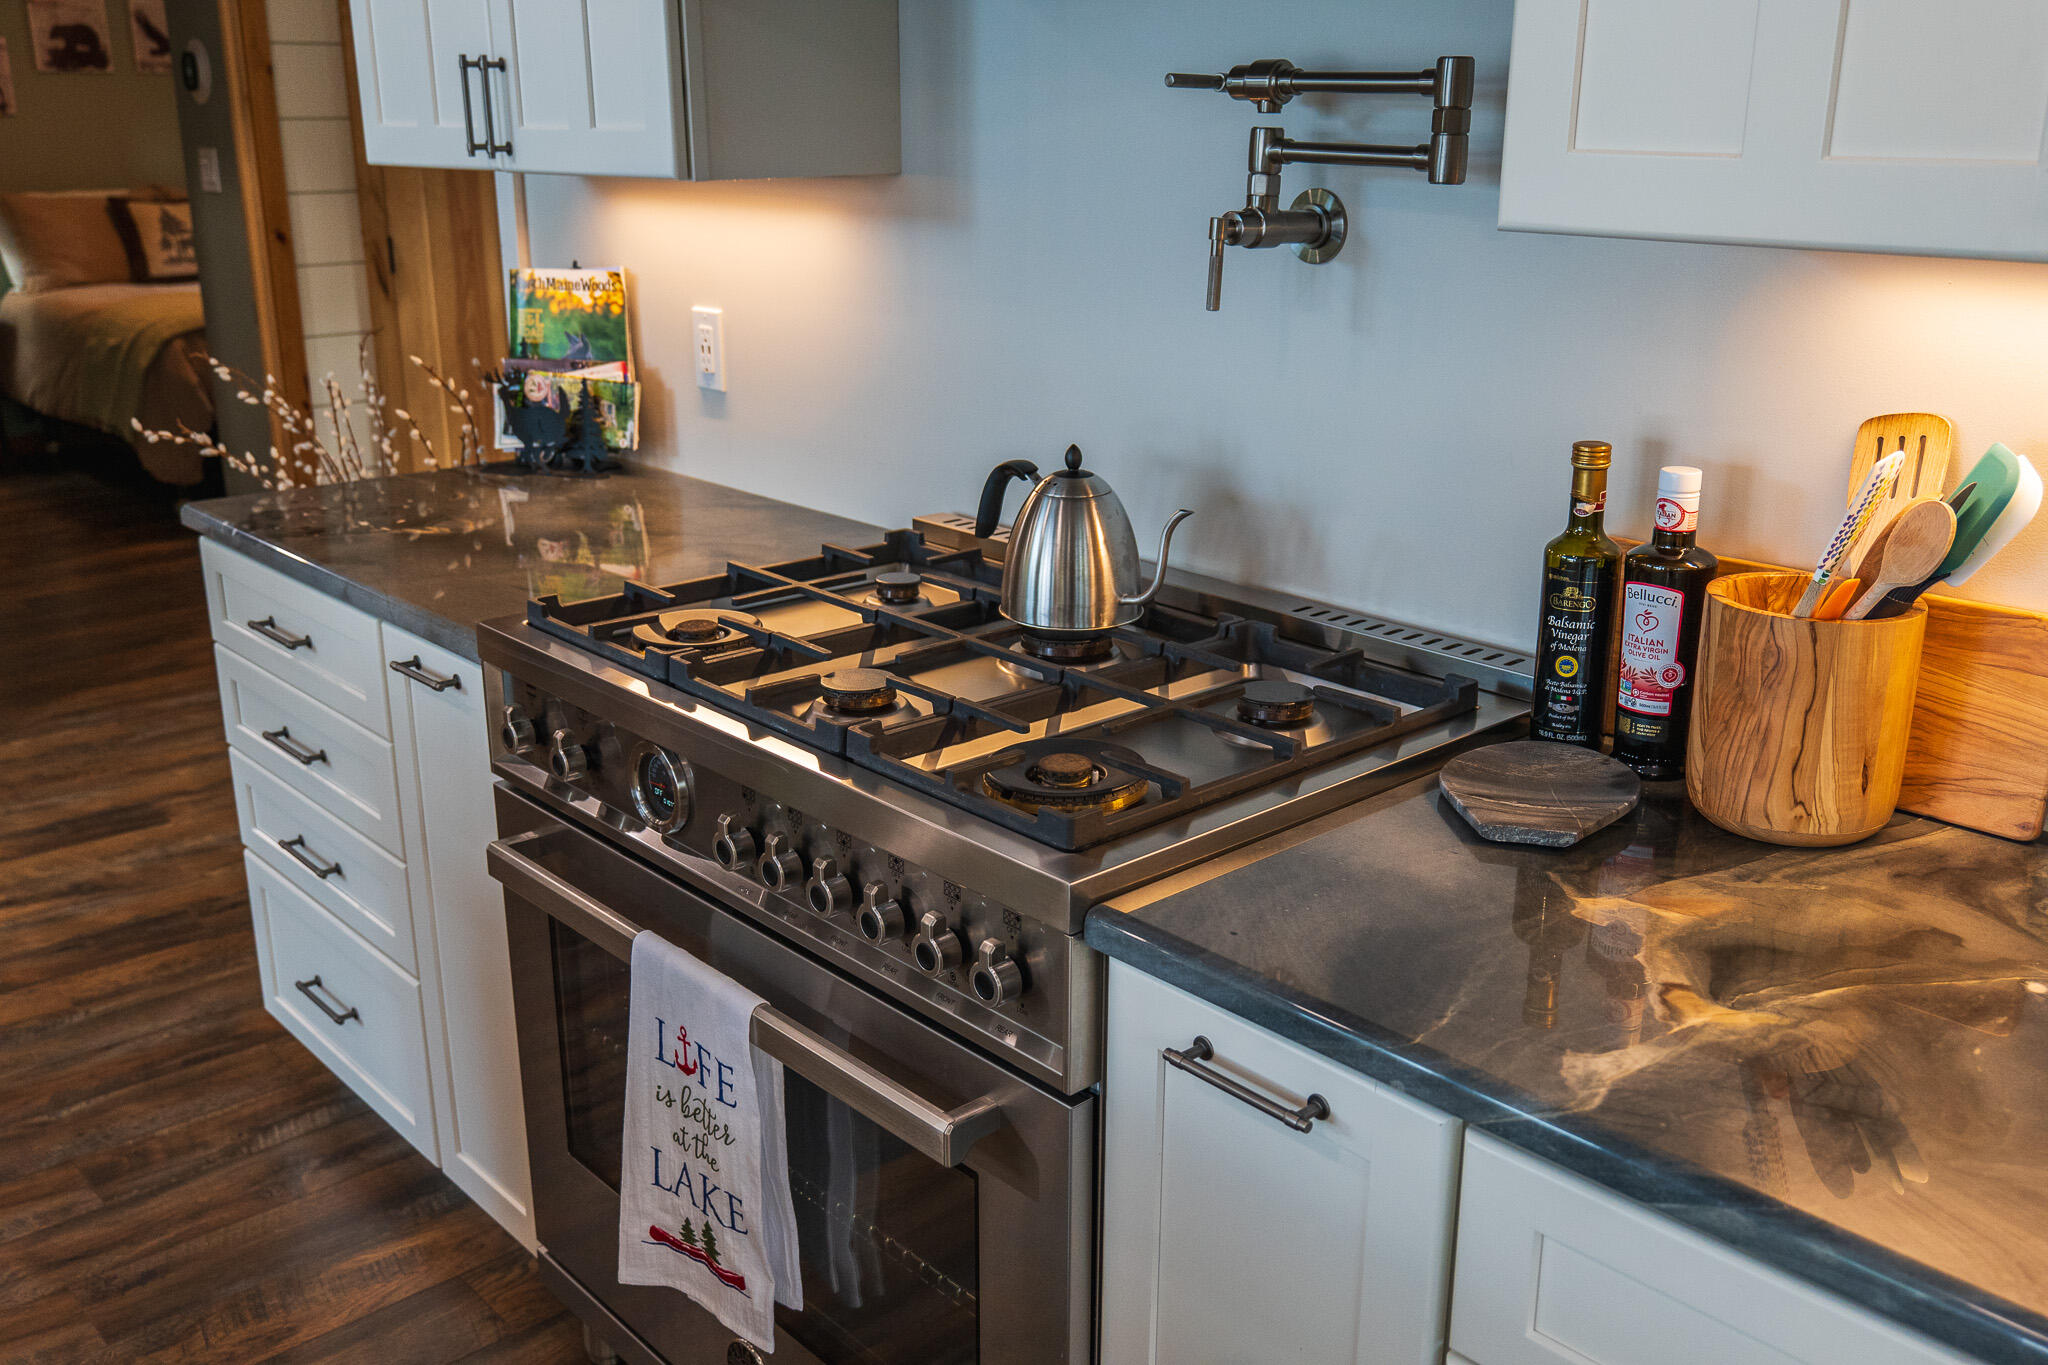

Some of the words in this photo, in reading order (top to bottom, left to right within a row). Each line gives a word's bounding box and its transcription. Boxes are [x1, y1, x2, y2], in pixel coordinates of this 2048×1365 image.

[1552, 596, 1593, 609] BARENGO
[1547, 615, 1596, 630] Balsamic
[1551, 627, 1590, 644] Vinegar
[1628, 632, 1664, 647] ITALIAN
[1550, 640, 1559, 651] of
[1558, 643, 1587, 652] Modena
[1624, 640, 1642, 651] EXTRA
[1643, 646, 1669, 655] VIRGIN
[1627, 648, 1647, 658] OLIVE
[1648, 653, 1661, 661] OIL
[881, 962, 898, 976] REAR
[994, 1024, 1014, 1038] REAR
[656, 1084, 676, 1107] is
[680, 1085, 736, 1147] better
[672, 1127, 692, 1152] at
[692, 1132, 720, 1172] the
[650, 1145, 748, 1235] LAKE
